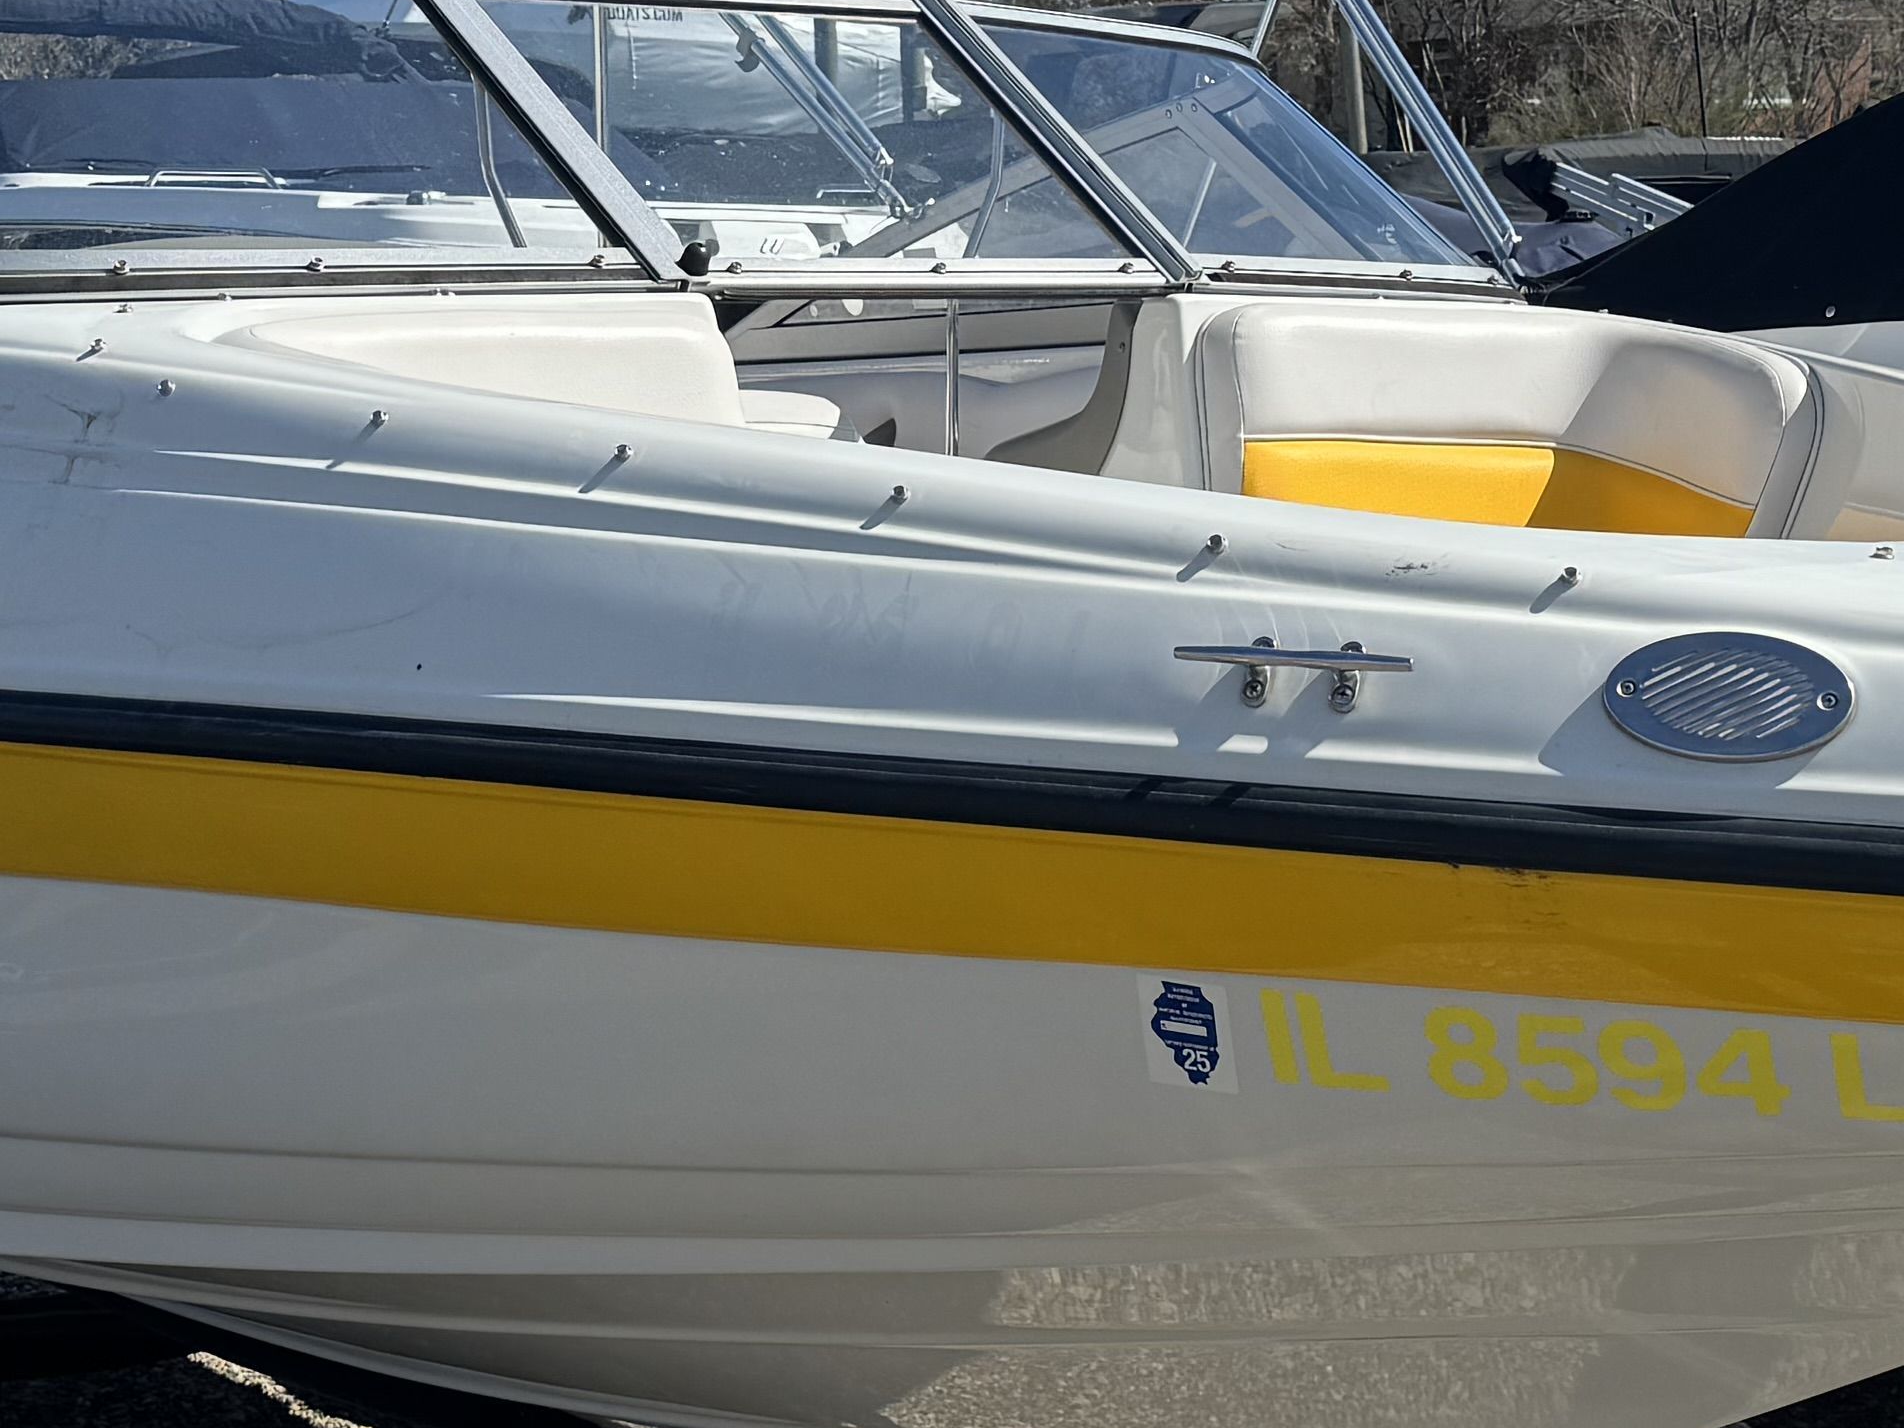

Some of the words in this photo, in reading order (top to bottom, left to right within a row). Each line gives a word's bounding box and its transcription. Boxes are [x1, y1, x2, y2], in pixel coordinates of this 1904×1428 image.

[1182, 1048, 1212, 1073] 25
[1259, 988, 1389, 1093] IL
[1423, 1006, 1790, 1117] 8594
